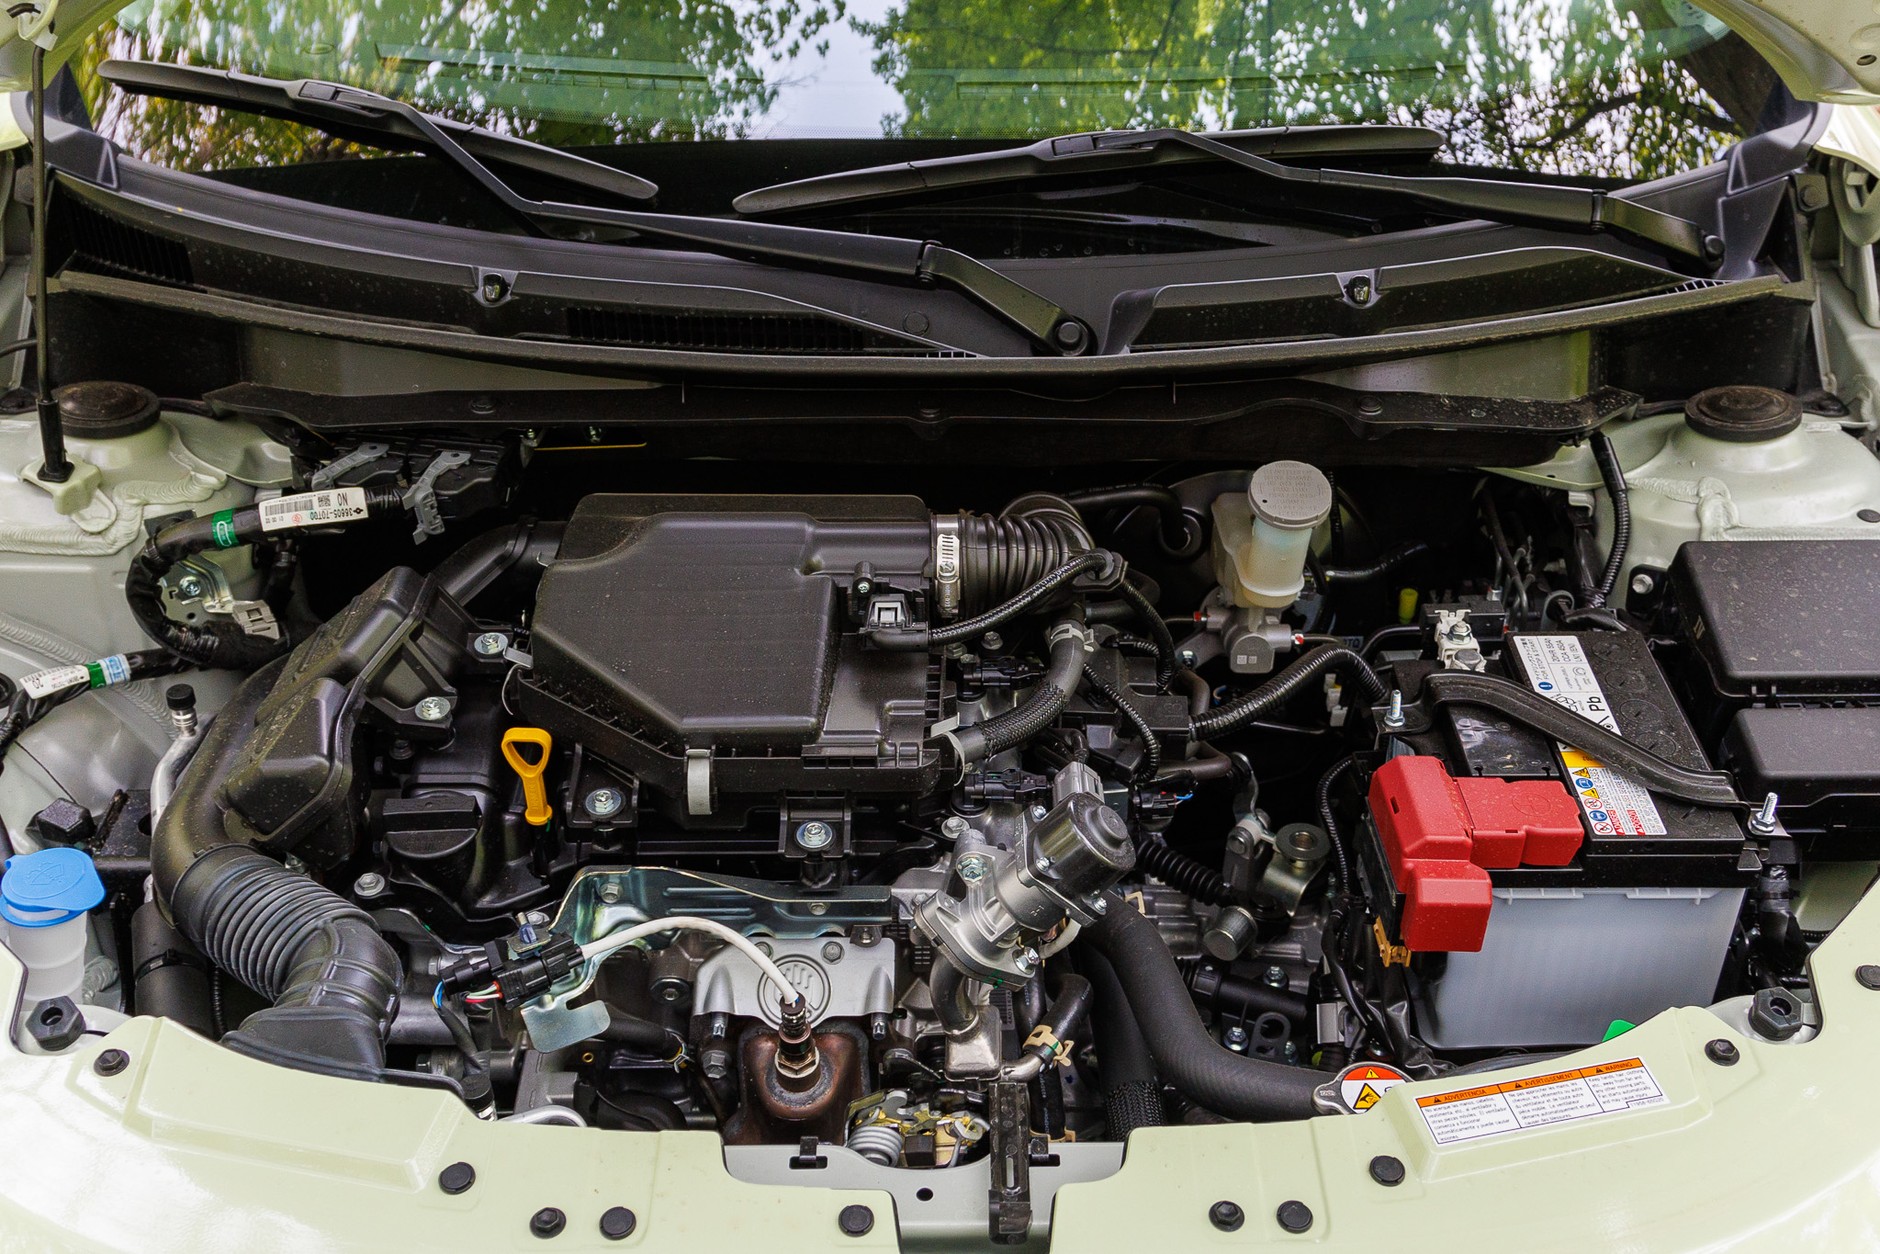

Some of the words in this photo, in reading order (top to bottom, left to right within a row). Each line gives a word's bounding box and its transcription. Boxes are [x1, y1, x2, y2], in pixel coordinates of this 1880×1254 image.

[1536, 657, 1546, 670] STOP
[1587, 696, 1605, 712] Pb
[1604, 1062, 1632, 1071] WARNING
[1525, 1073, 1573, 1086] AVERTISSEMENT
[1444, 1089, 1486, 1101] ADVERTENCIA
